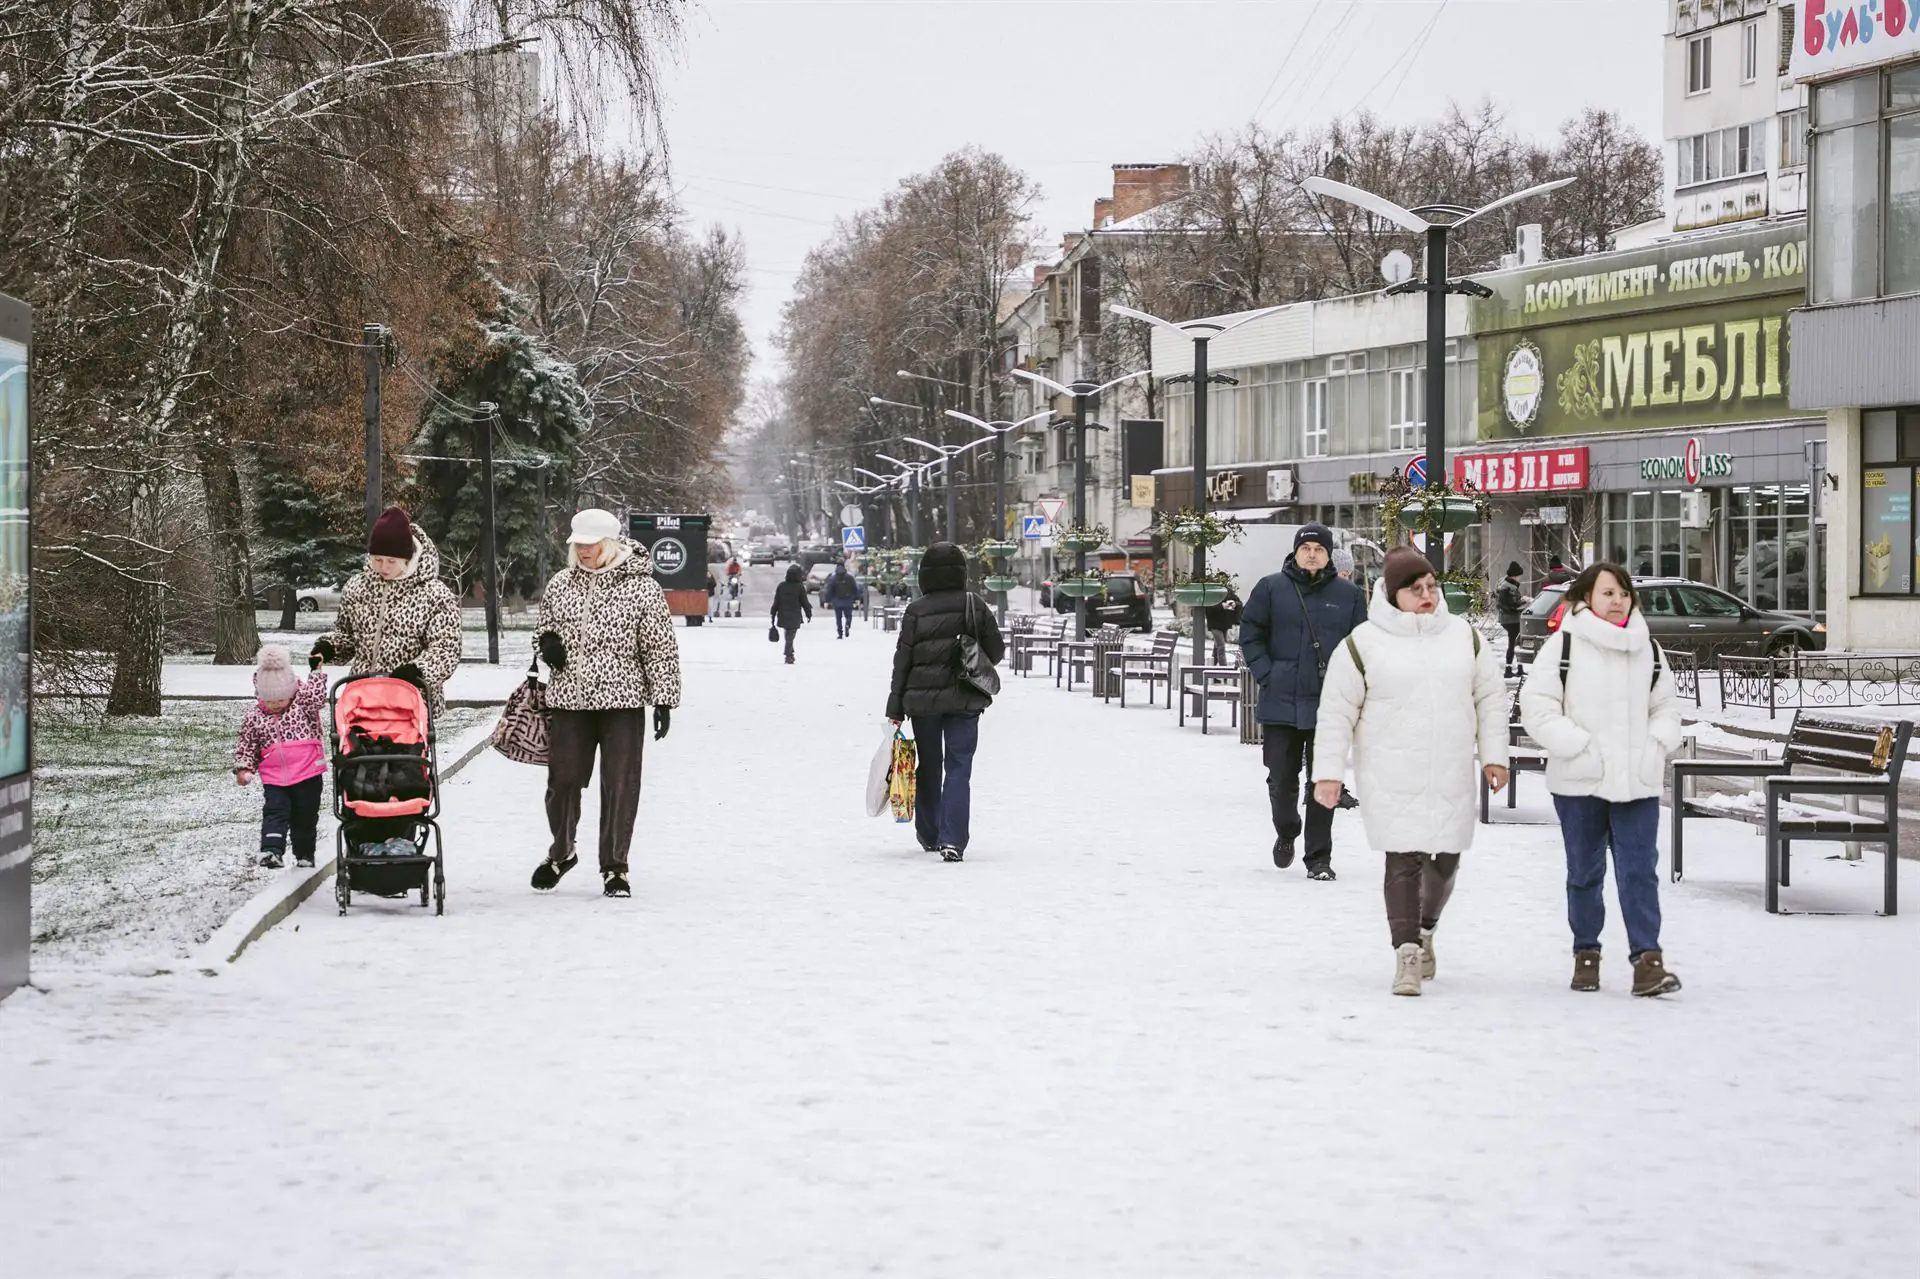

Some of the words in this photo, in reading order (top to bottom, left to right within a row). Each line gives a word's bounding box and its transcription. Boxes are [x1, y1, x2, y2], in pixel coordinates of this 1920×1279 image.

[1524, 264, 1658, 313] АСОРТИМЕНТ
[1668, 250, 1751, 293] ЯКІСТЬ
[1602, 316, 1782, 409] МЕБЛІ
[1464, 455, 1549, 490] МЕБЛІ
[656, 516, 680, 526] Pilot
[656, 550, 680, 561] Pilot
